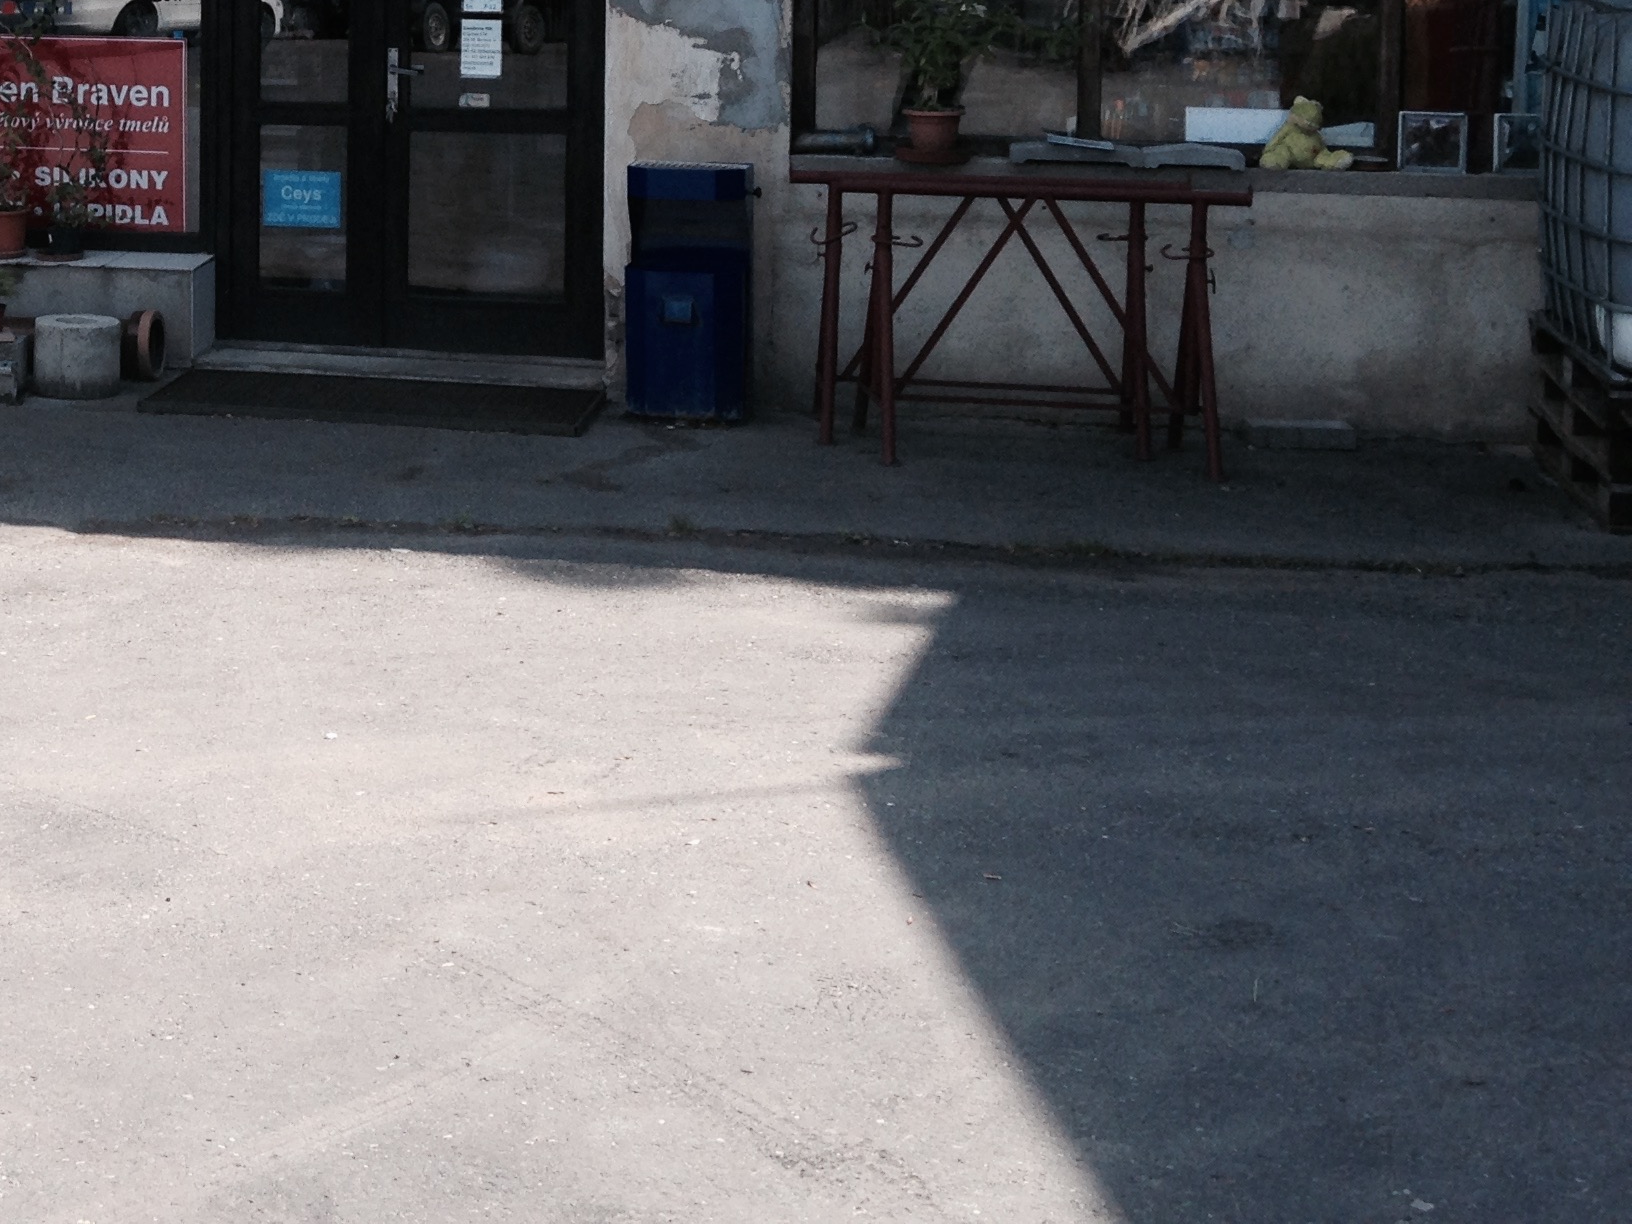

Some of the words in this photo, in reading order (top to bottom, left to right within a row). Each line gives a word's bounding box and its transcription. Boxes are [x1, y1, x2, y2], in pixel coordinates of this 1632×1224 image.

[51, 75, 171, 108] Braven
[118, 115, 170, 134] tmelů
[281, 184, 322, 204] Ceys
